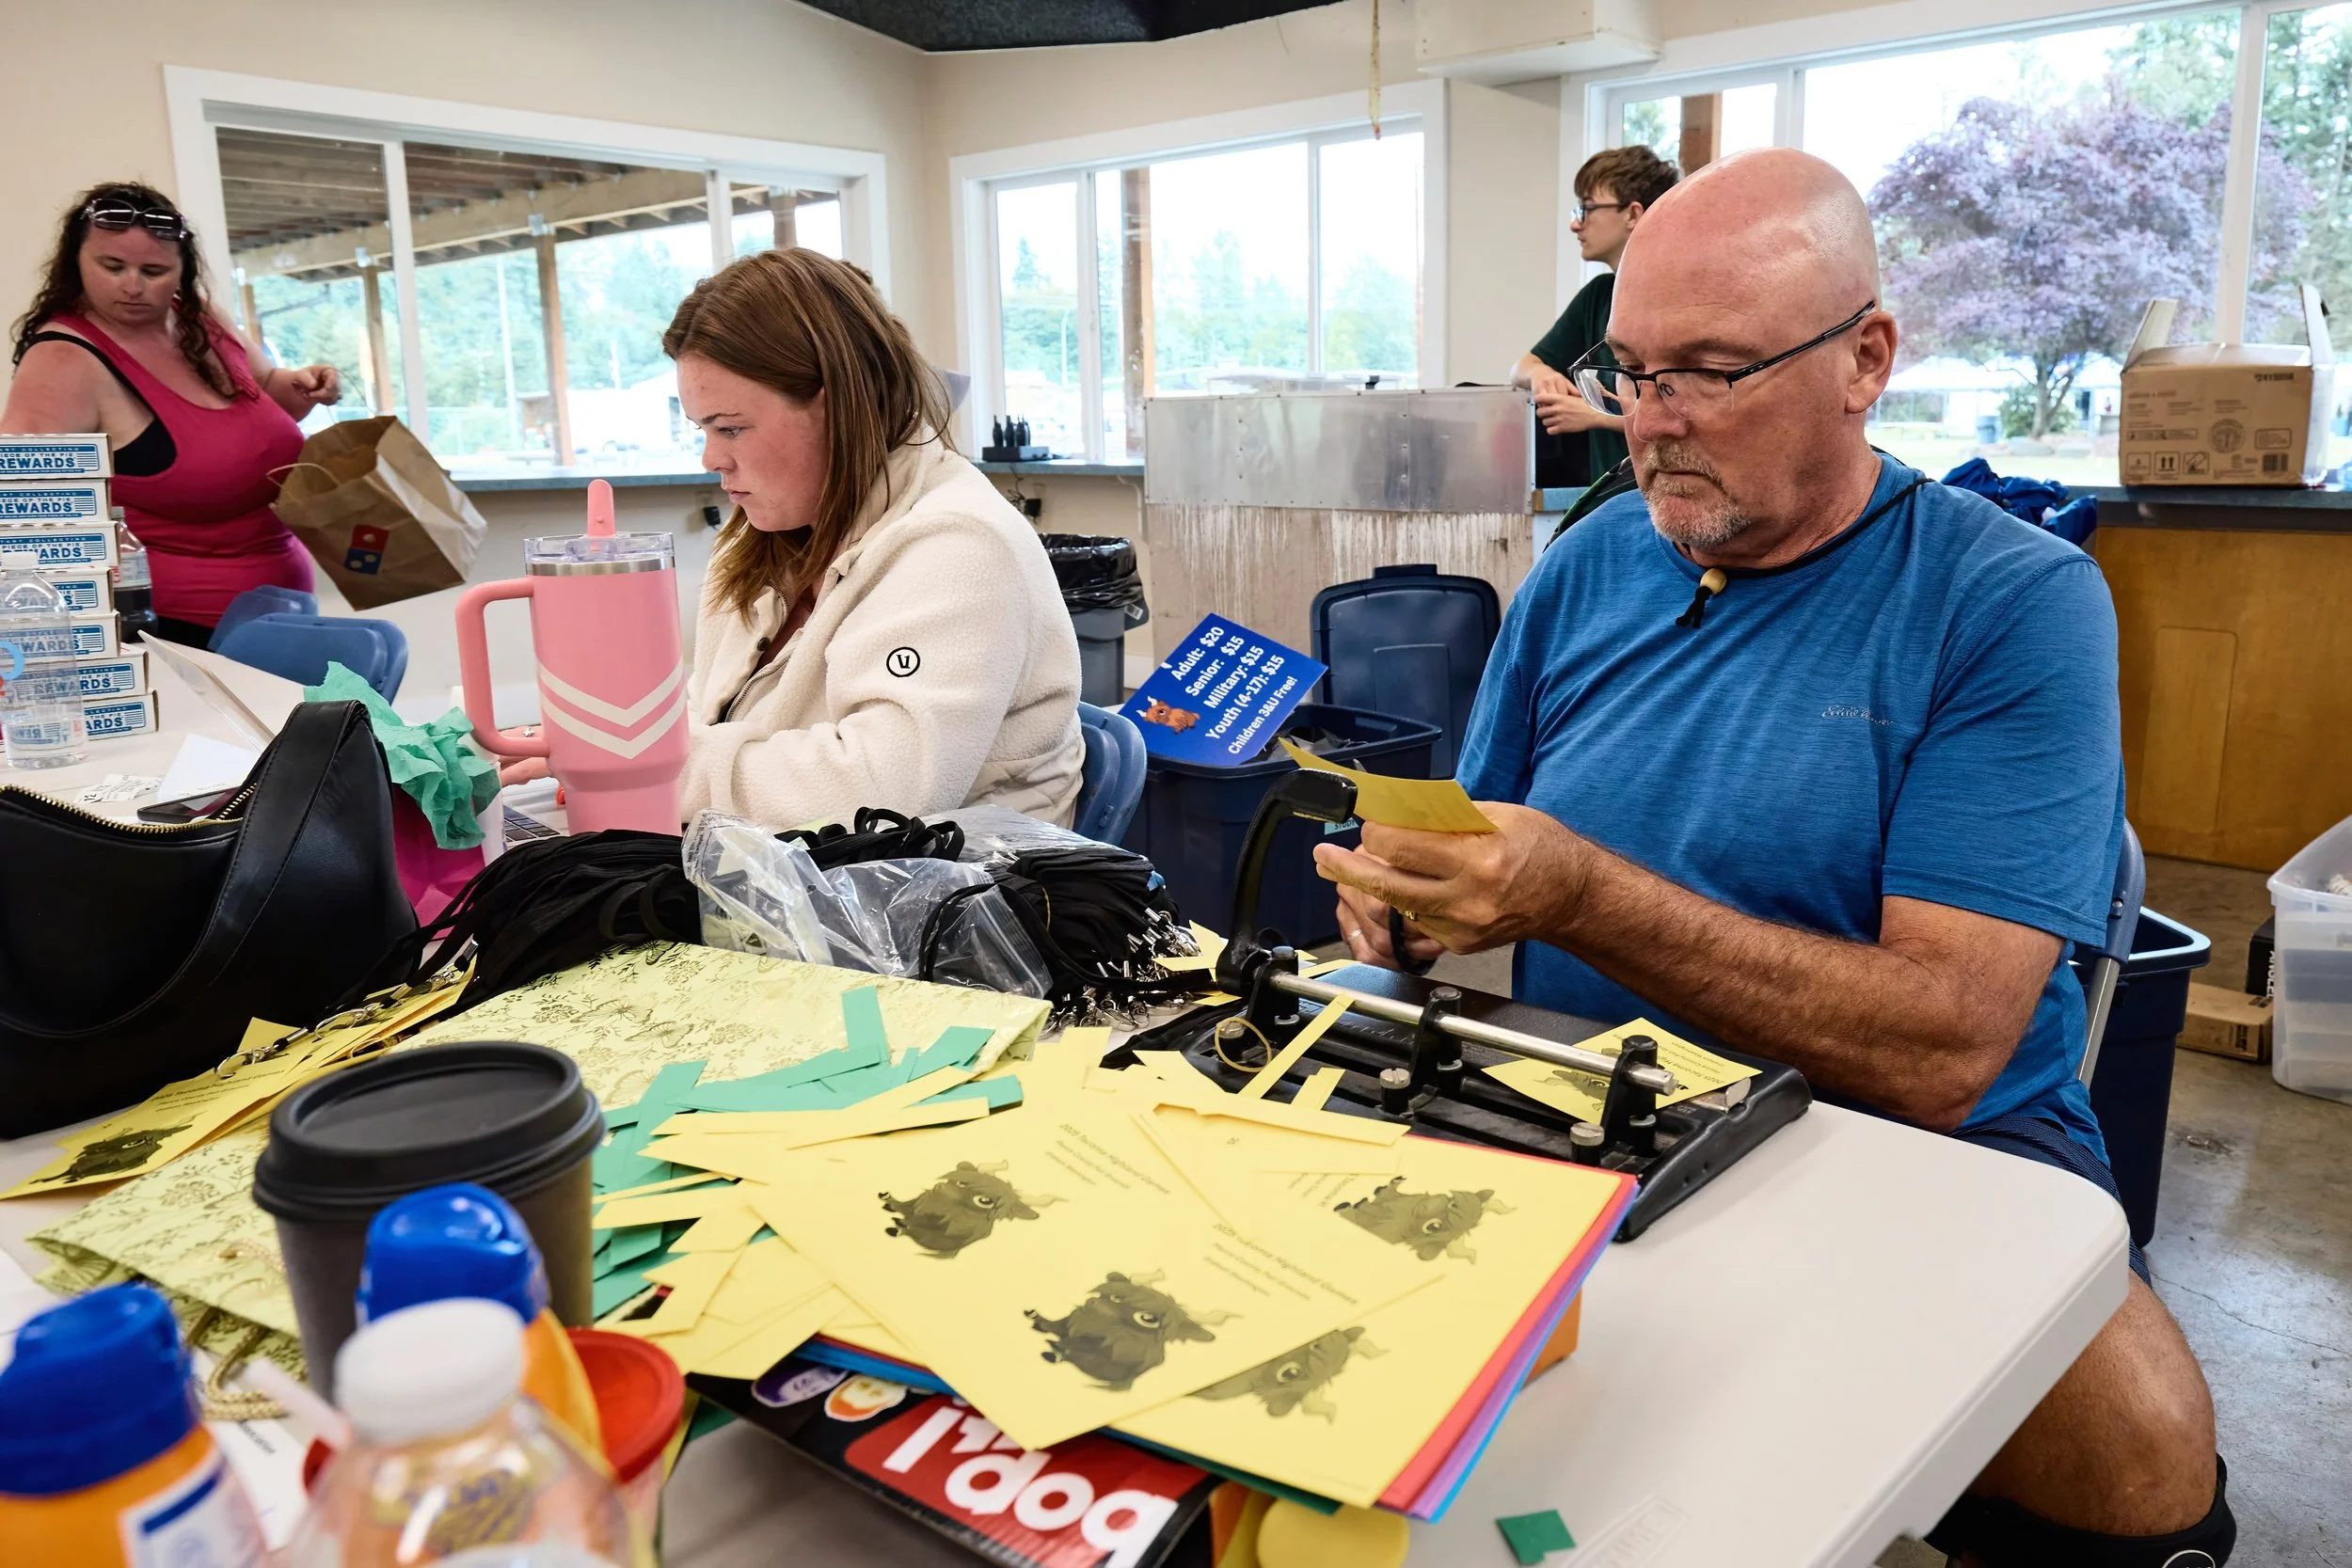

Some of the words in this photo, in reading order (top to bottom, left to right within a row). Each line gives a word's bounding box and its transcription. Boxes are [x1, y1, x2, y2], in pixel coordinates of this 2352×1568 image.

[1171, 648, 1206, 681] Adult:
[1200, 626, 1225, 647] $20
[1185, 658, 1225, 696] Senior:
[1220, 635, 1245, 657] $15
[1203, 664, 1248, 708] Military:
[1240, 645, 1264, 667] $15
[1205, 705, 1242, 740] Youth
[1233, 674, 1269, 707] (4-17):
[1261, 655, 1285, 675] $15
[1228, 715, 1265, 755] Children
[1258, 697, 1279, 717] 3&U
[1273, 676, 1298, 699] Free!
